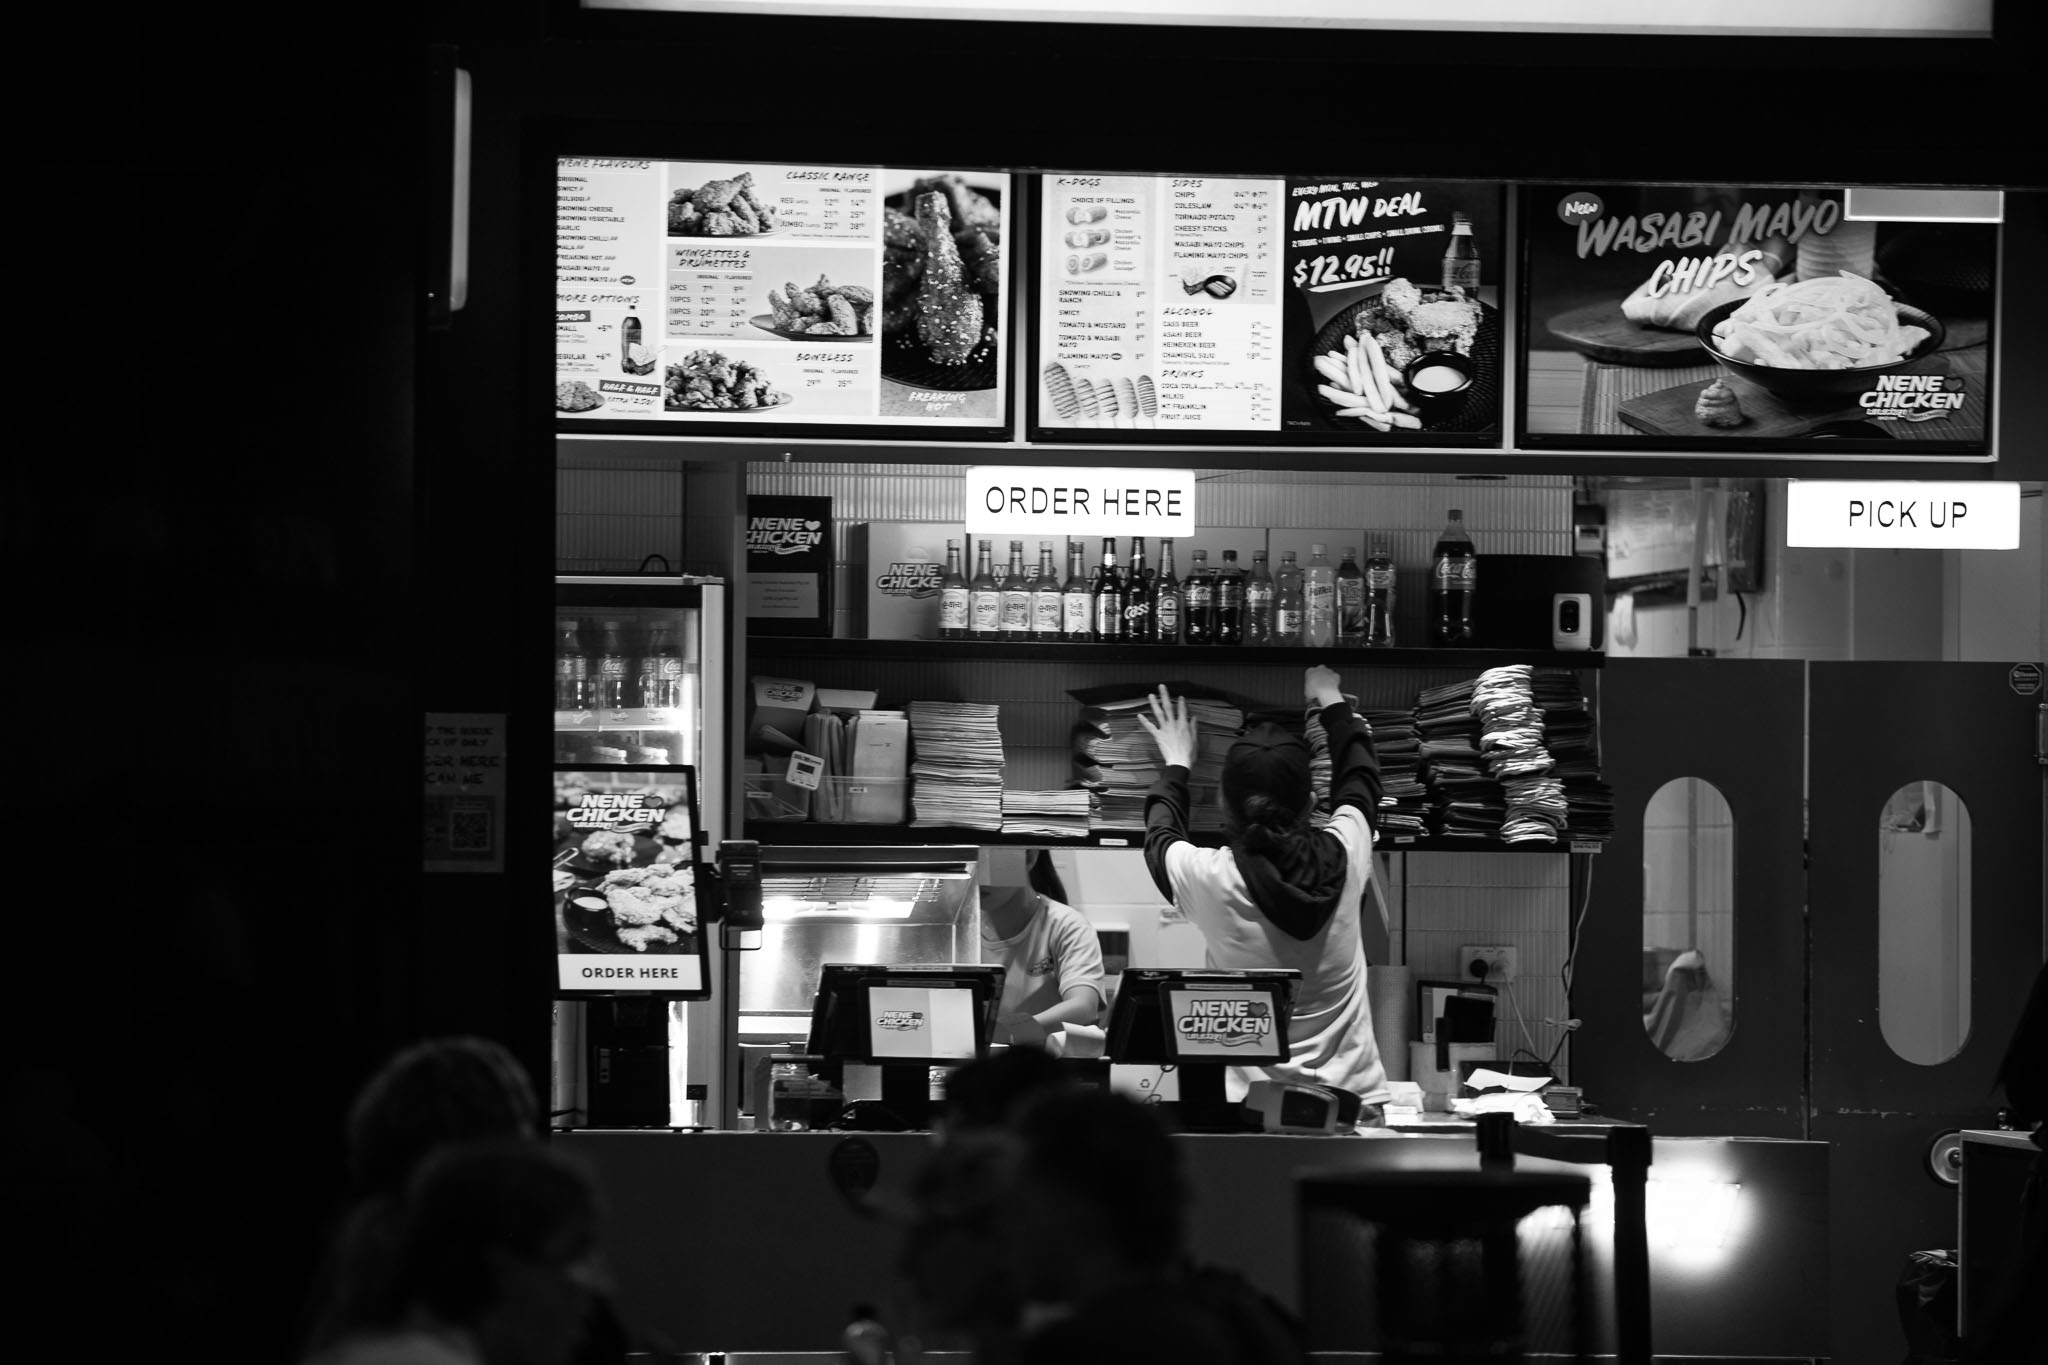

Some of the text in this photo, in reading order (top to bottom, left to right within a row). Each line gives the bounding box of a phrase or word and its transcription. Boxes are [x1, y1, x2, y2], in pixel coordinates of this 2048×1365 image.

[786, 172, 870, 182] CLASSIC RANGE
[1056, 178, 1101, 187] K-DOGS
[1172, 180, 1203, 188] SIDES
[1293, 196, 1369, 232] MTW
[1372, 191, 1427, 218] DEAL
[1564, 201, 1599, 216] New
[1576, 200, 1840, 259] WASABI MAYO
[675, 249, 740, 258] WINGETTES
[679, 259, 747, 268] DRUMETTES
[1292, 246, 1394, 288] $12.95!!
[1648, 250, 1763, 299] CHIPS
[591, 294, 640, 304] OPTIONS
[1162, 308, 1214, 316] ALCOHOL
[796, 353, 854, 362] BONELESS
[1161, 370, 1204, 378] DRINKS
[1876, 375, 1944, 392] NENE
[908, 392, 967, 403] FREAKING
[1859, 392, 1966, 409] CHICKEN
[925, 402, 950, 411] HOT
[986, 486, 1182, 517] ORDER HERE
[1850, 500, 1968, 528] PICK UP
[750, 517, 806, 530] NENE
[890, 564, 940, 576] NENE
[877, 576, 944, 588] CHICKE
[581, 794, 646, 808] NENE
[566, 808, 666, 822] CHICKEN
[582, 967, 679, 979] ORDER HERE
[1191, 1001, 1249, 1016] NENE
[876, 1018, 924, 1026] CHICKEN
[1179, 1017, 1271, 1033] CHICKEN
